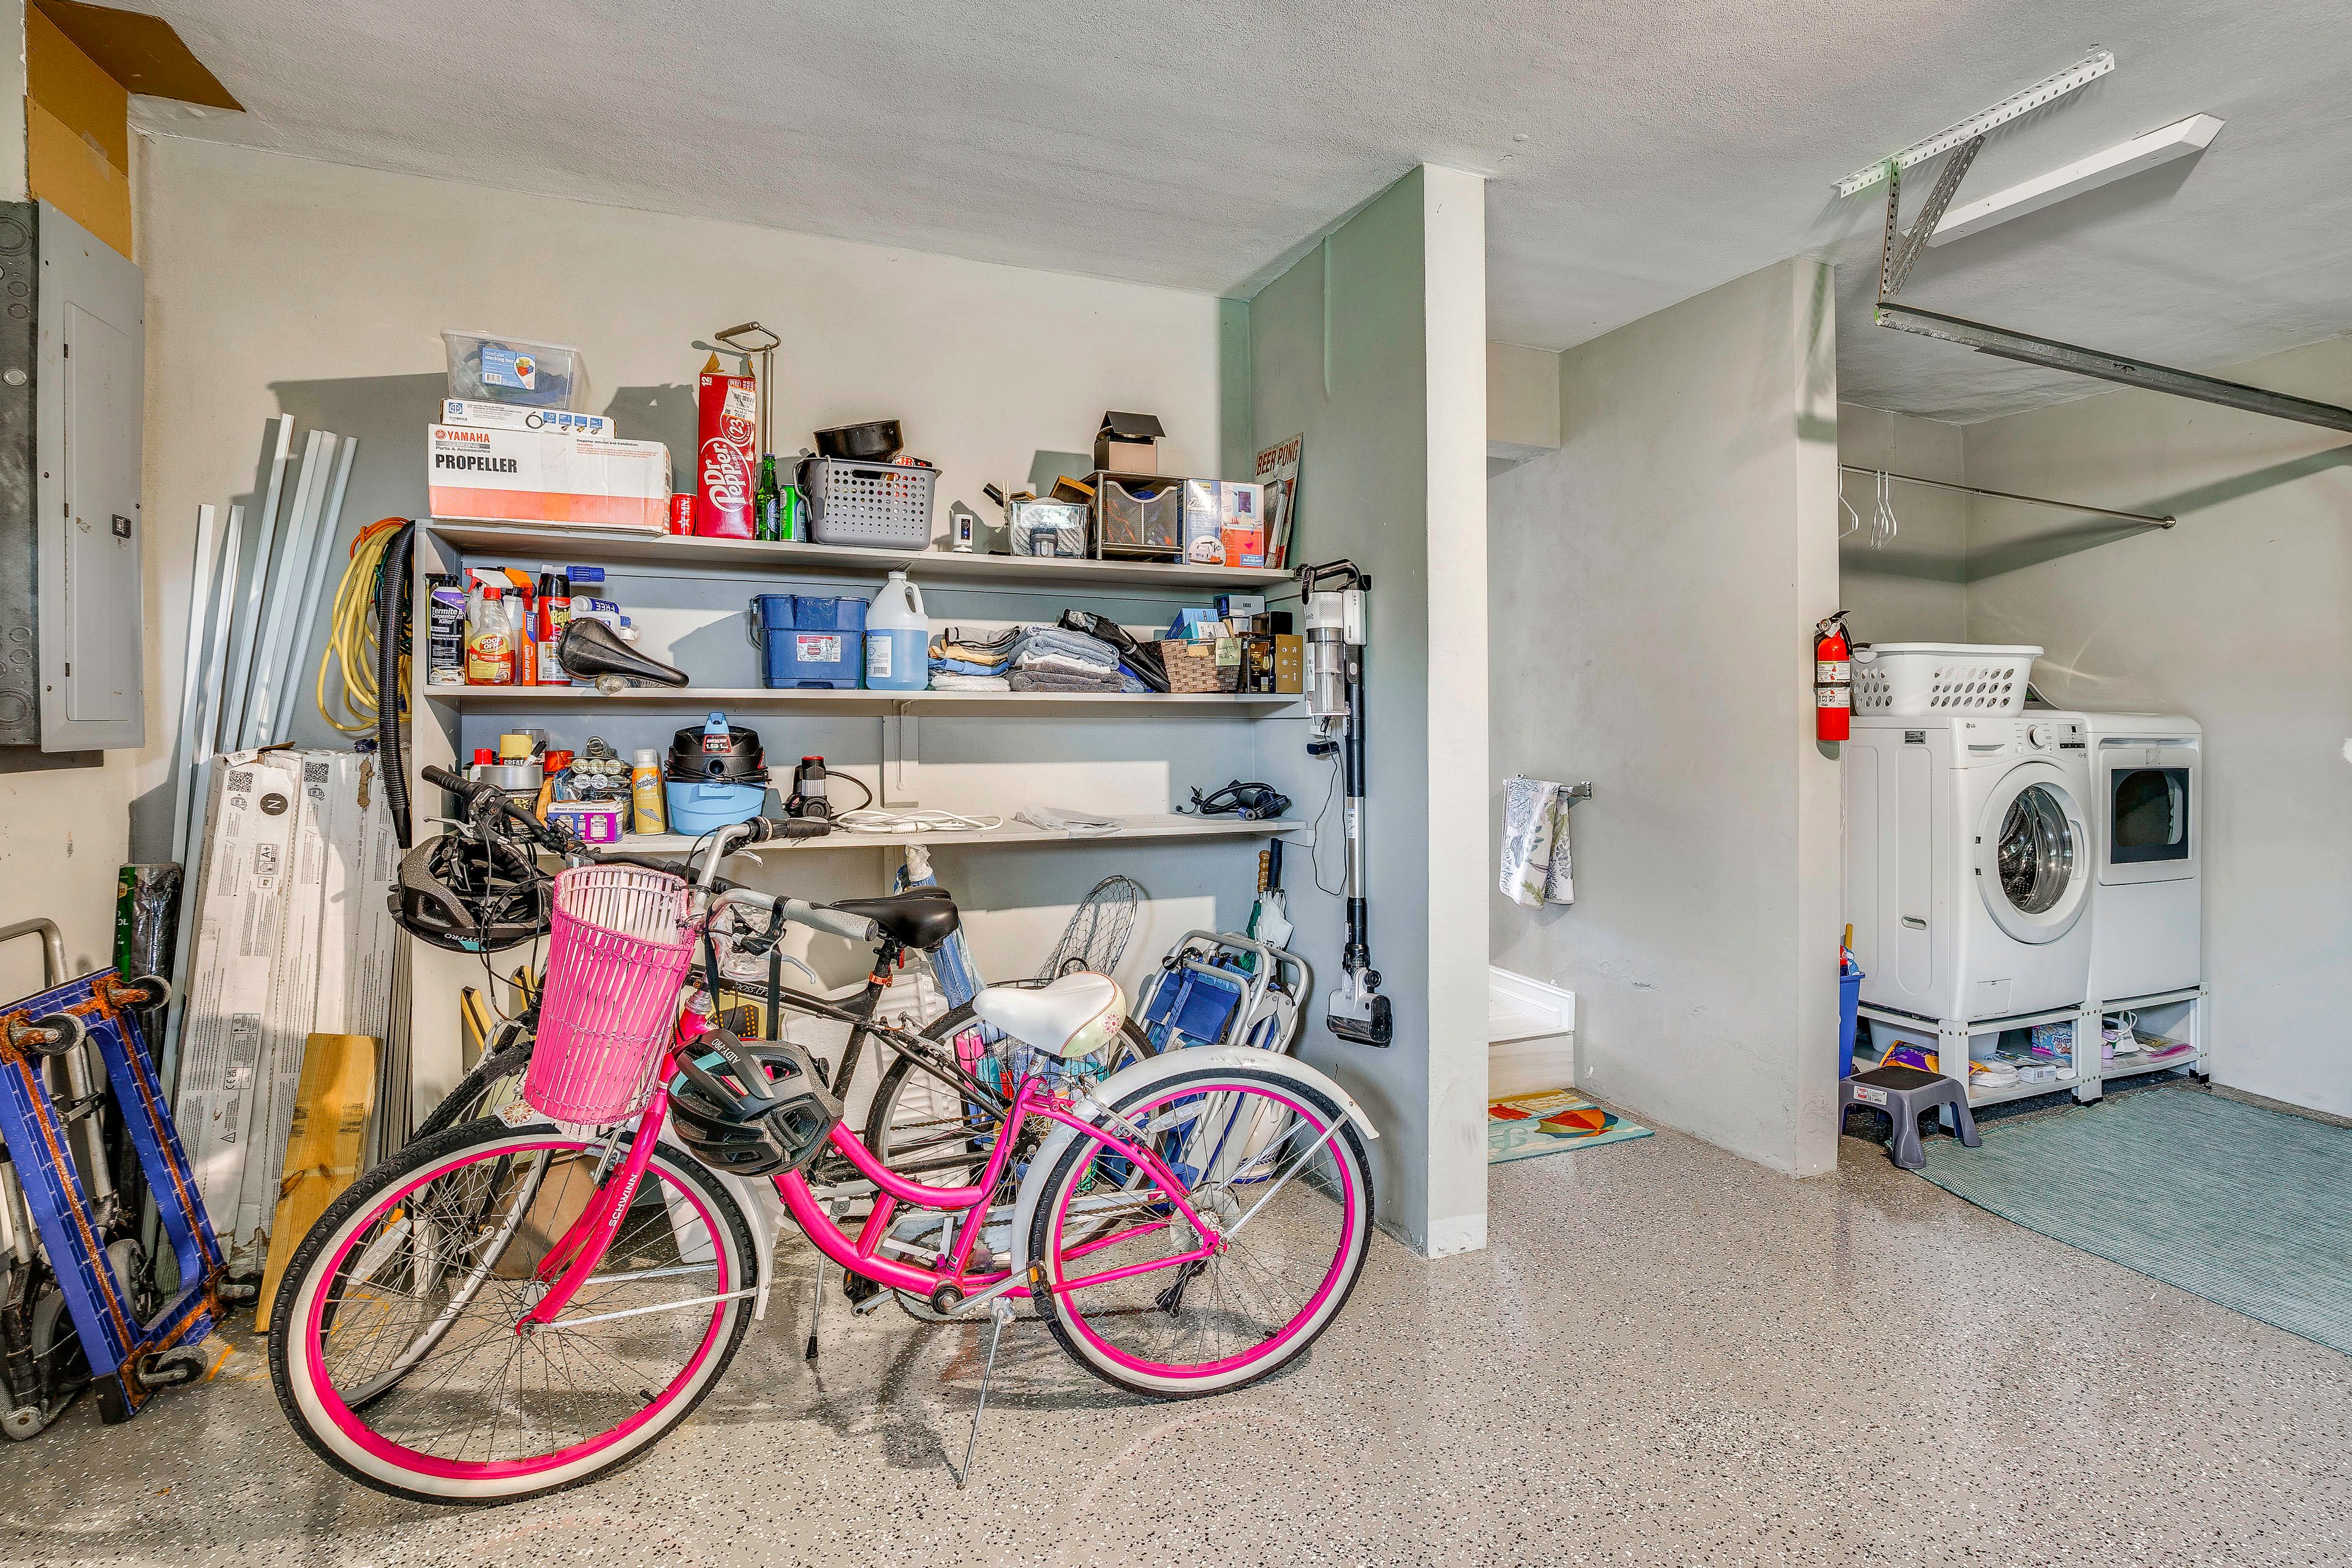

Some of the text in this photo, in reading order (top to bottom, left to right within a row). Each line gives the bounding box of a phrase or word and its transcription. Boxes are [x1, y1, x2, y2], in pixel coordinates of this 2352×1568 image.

[701, 377, 708, 386] 12
[729, 419, 744, 434] 23
[447, 431, 490, 443] YAMAHA
[435, 454, 518, 473] PROPELLER
[1256, 440, 1299, 477] BEER PONG
[704, 459, 726, 485] Dr
[595, 601, 616, 612] FREE
[551, 608, 571, 624] Raid
[1218, 645, 1236, 654] Light
[267, 799, 281, 809] N
[261, 846, 271, 858] A+
[711, 1038, 741, 1065] AIDY-PRO
[608, 1173, 638, 1227] SCHWINN
